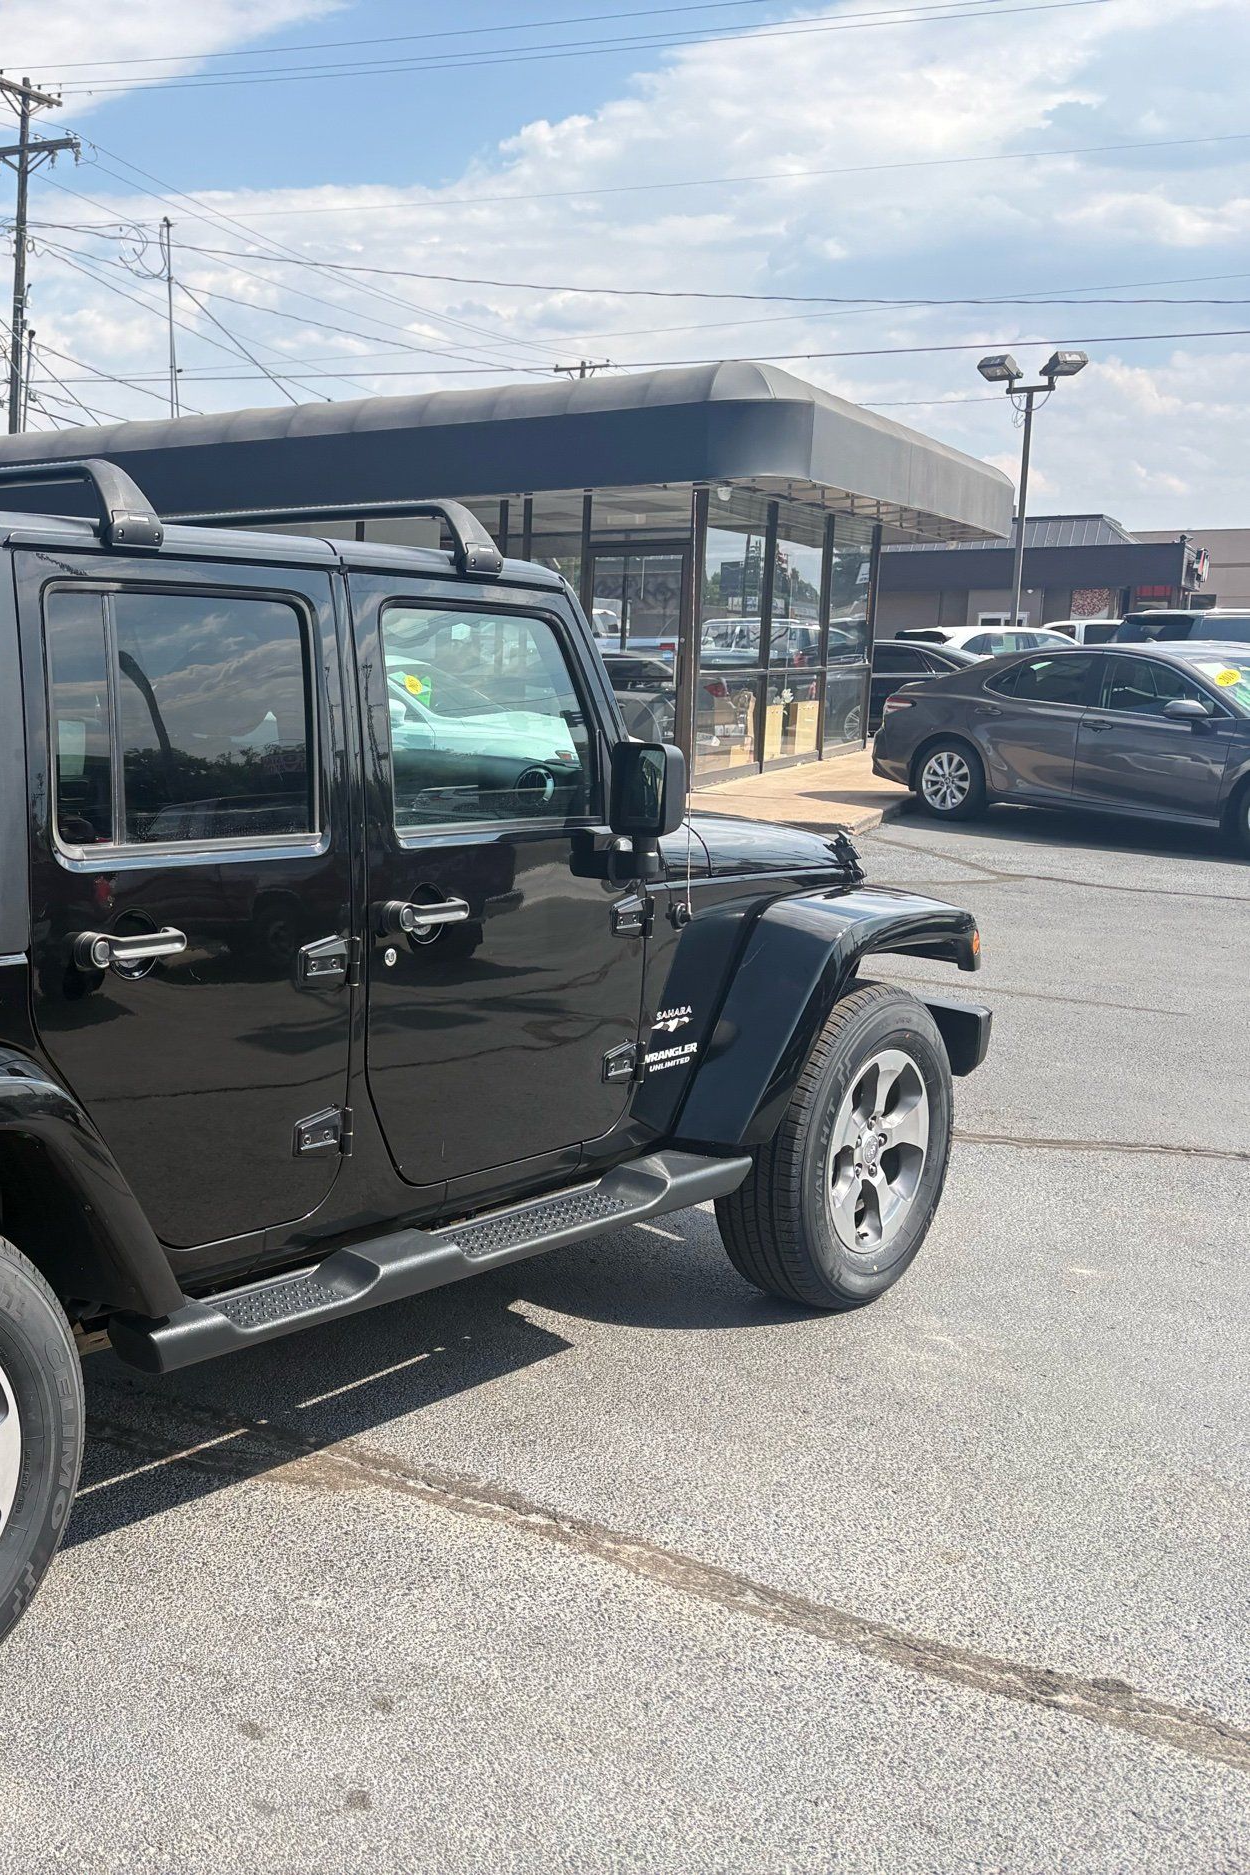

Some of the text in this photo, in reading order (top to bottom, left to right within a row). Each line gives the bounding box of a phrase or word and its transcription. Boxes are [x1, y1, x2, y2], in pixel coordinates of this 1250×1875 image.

[656, 1005, 692, 1021] SAHARA
[644, 1042, 698, 1063] WRANGLER
[649, 1056, 691, 1072] UNLIMITED
[44, 1337, 77, 1531] CELIMO
